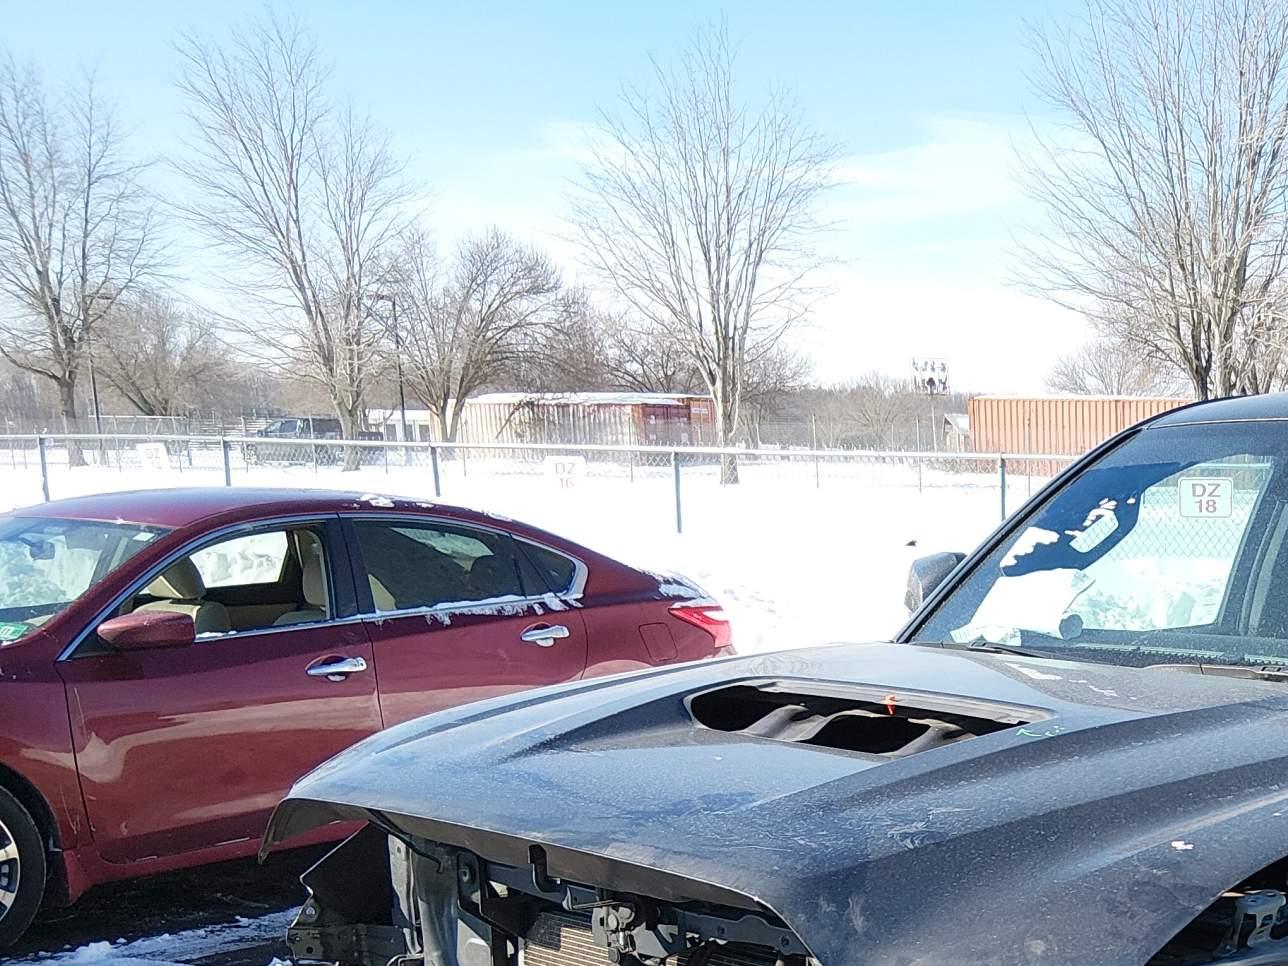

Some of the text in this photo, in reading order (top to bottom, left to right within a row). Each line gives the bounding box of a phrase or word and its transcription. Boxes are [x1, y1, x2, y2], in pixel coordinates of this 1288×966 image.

[555, 462, 576, 475] DZ
[560, 477, 575, 489] 16
[1191, 482, 1221, 498] DZ
[1194, 498, 1217, 513] 18
